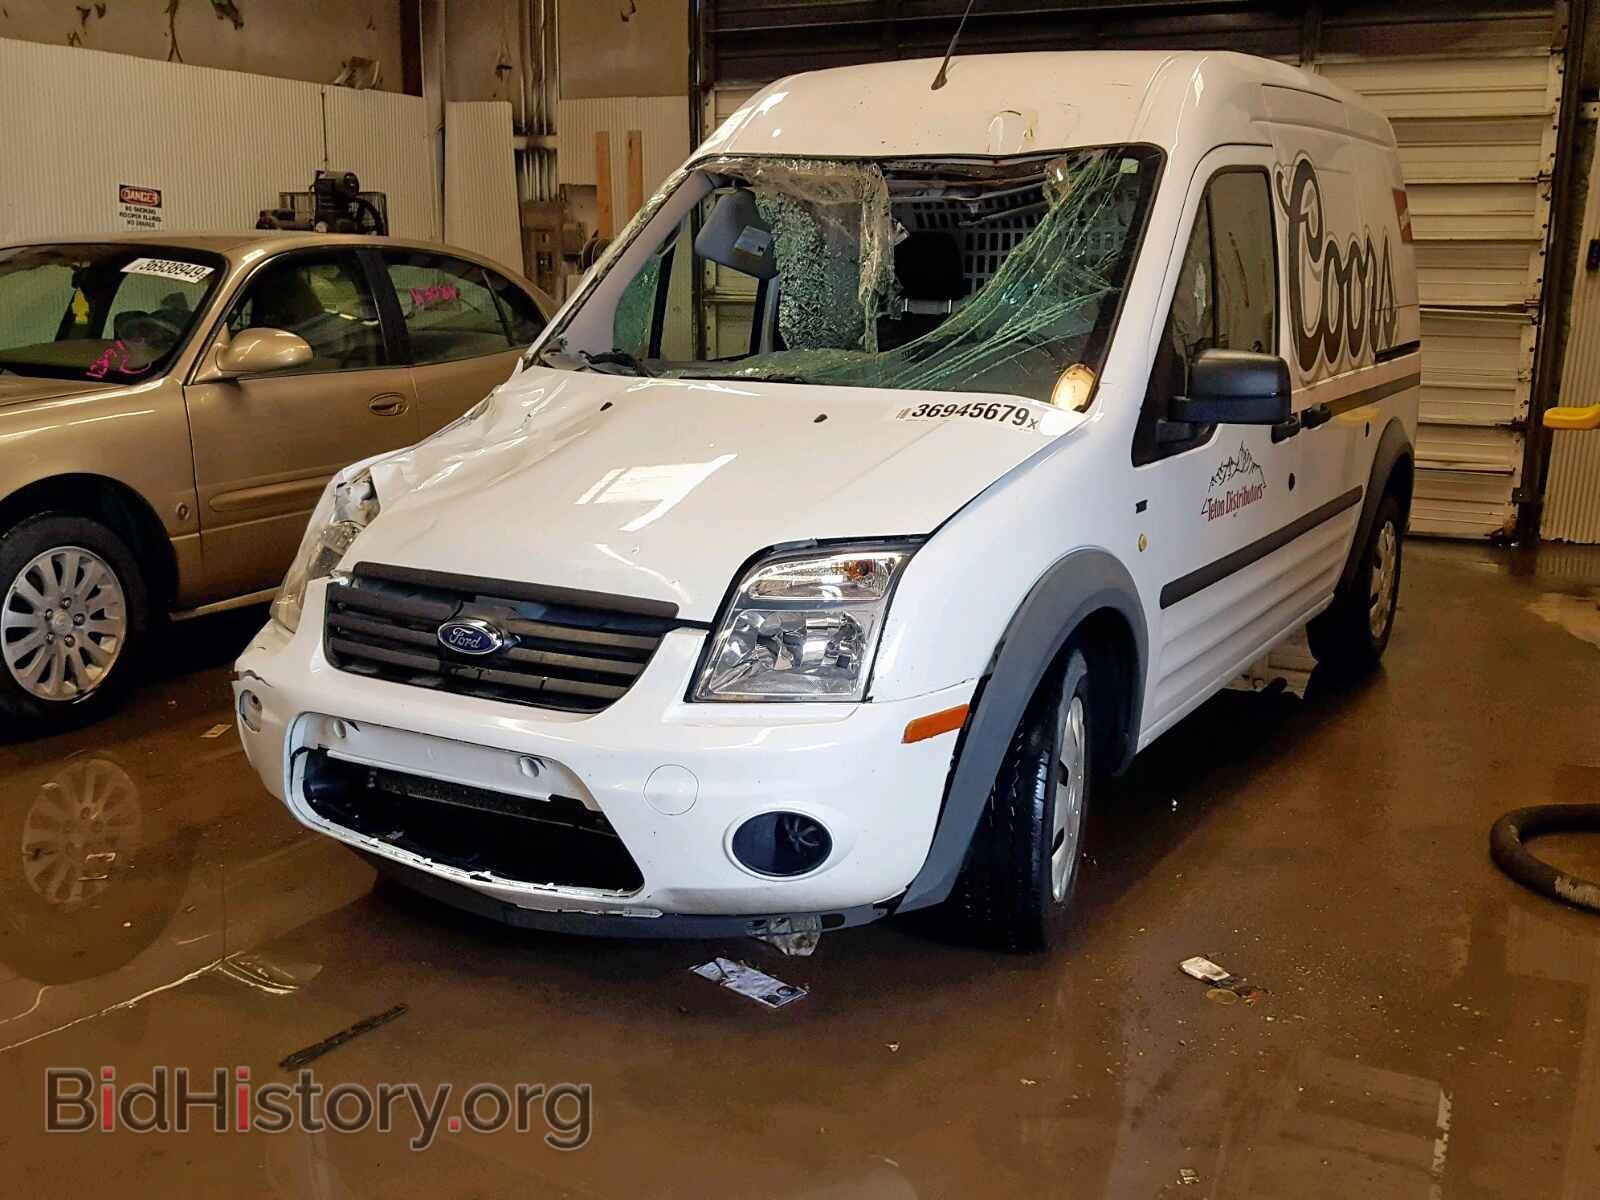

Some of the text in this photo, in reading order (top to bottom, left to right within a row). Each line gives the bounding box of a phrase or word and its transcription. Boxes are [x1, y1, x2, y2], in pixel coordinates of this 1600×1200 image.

[122, 190, 158, 205] DANGER
[1274, 152, 1398, 384] Coors
[1207, 487, 1263, 521] Teton Distributors
[448, 627, 482, 649] Ford
